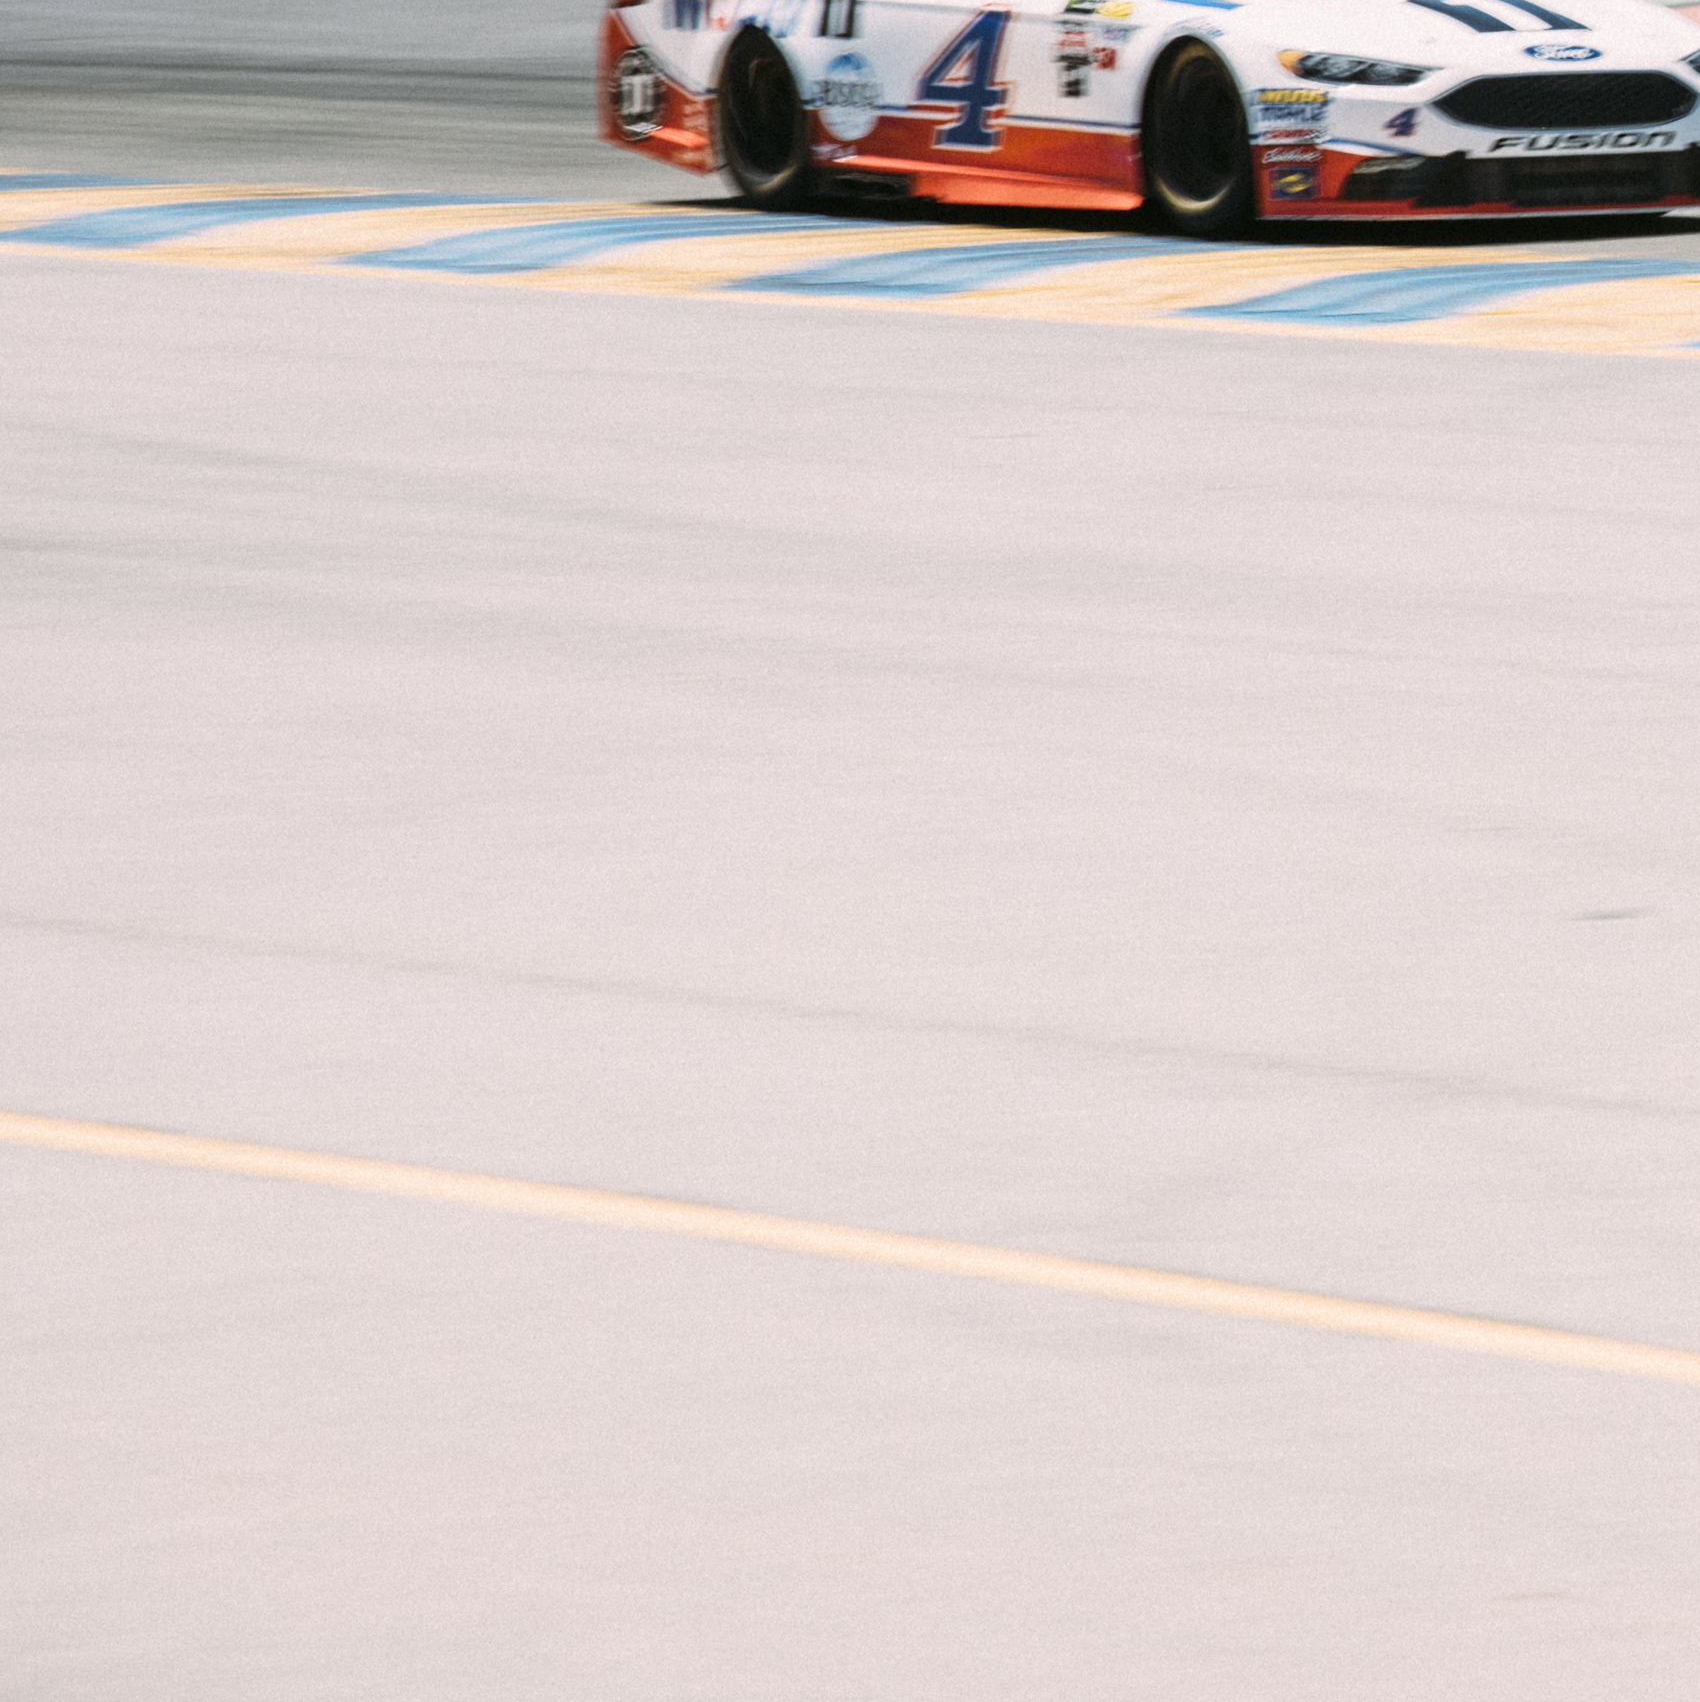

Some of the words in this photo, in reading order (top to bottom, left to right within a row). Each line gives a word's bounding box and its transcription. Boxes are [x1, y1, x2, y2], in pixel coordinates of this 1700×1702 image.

[914, 2, 1016, 154] 4
[1383, 107, 1420, 138] 4
[1488, 131, 1677, 152] FUSION
